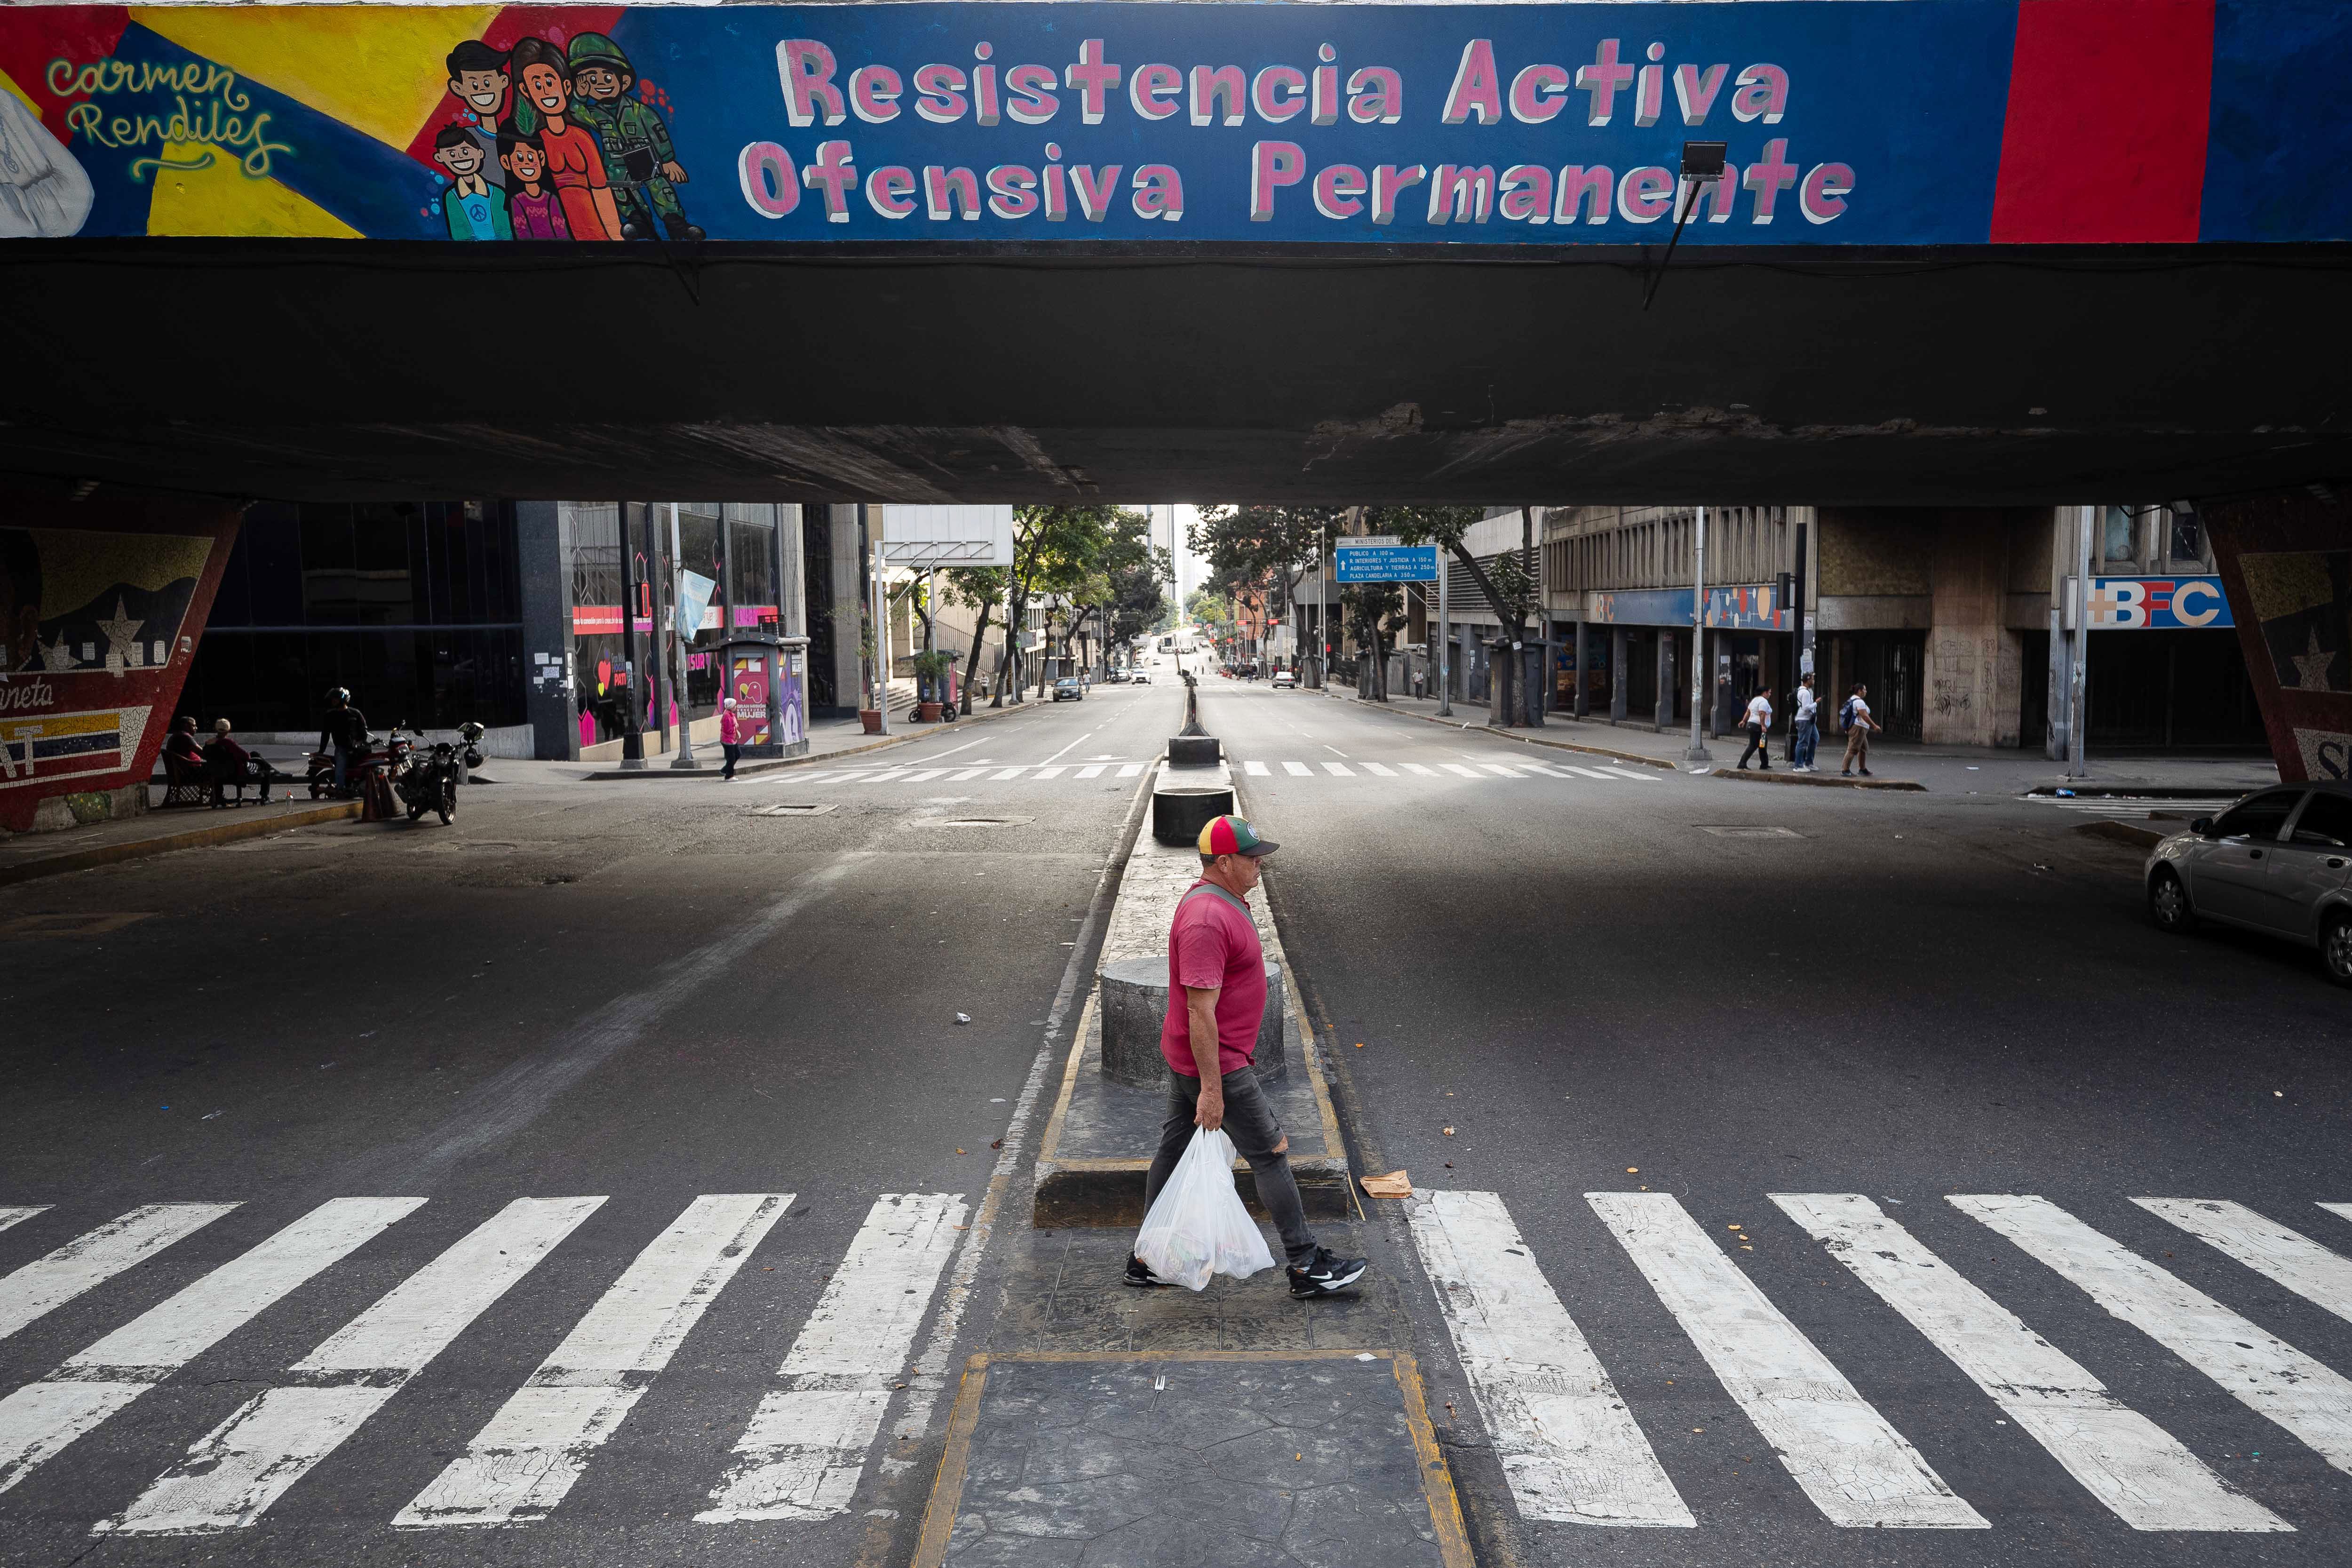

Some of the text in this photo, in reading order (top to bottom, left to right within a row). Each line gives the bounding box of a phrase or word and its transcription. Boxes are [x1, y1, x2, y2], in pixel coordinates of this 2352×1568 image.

[776, 38, 1789, 127] Resistencia Activa
[68, 96, 292, 176] Rendiles
[738, 140, 1183, 223] Ofensiva
